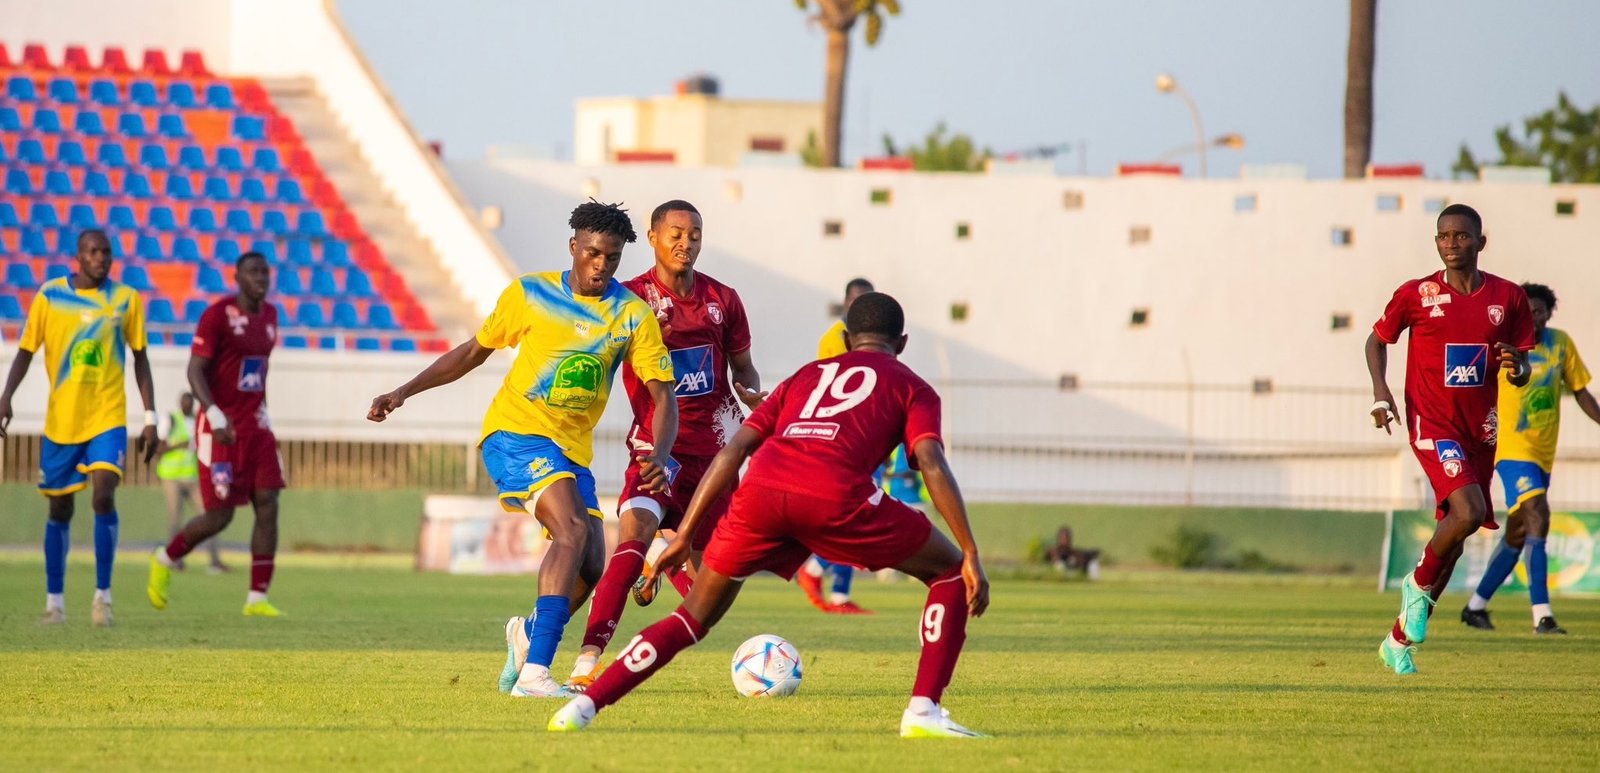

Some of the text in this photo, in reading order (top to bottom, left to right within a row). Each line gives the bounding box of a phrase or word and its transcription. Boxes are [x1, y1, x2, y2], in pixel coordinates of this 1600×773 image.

[674, 371, 709, 391] AXA
[1446, 365, 1479, 383] AXA
[799, 362, 877, 419] 19
[1440, 449, 1461, 461] AXA
[616, 634, 658, 673] 19
